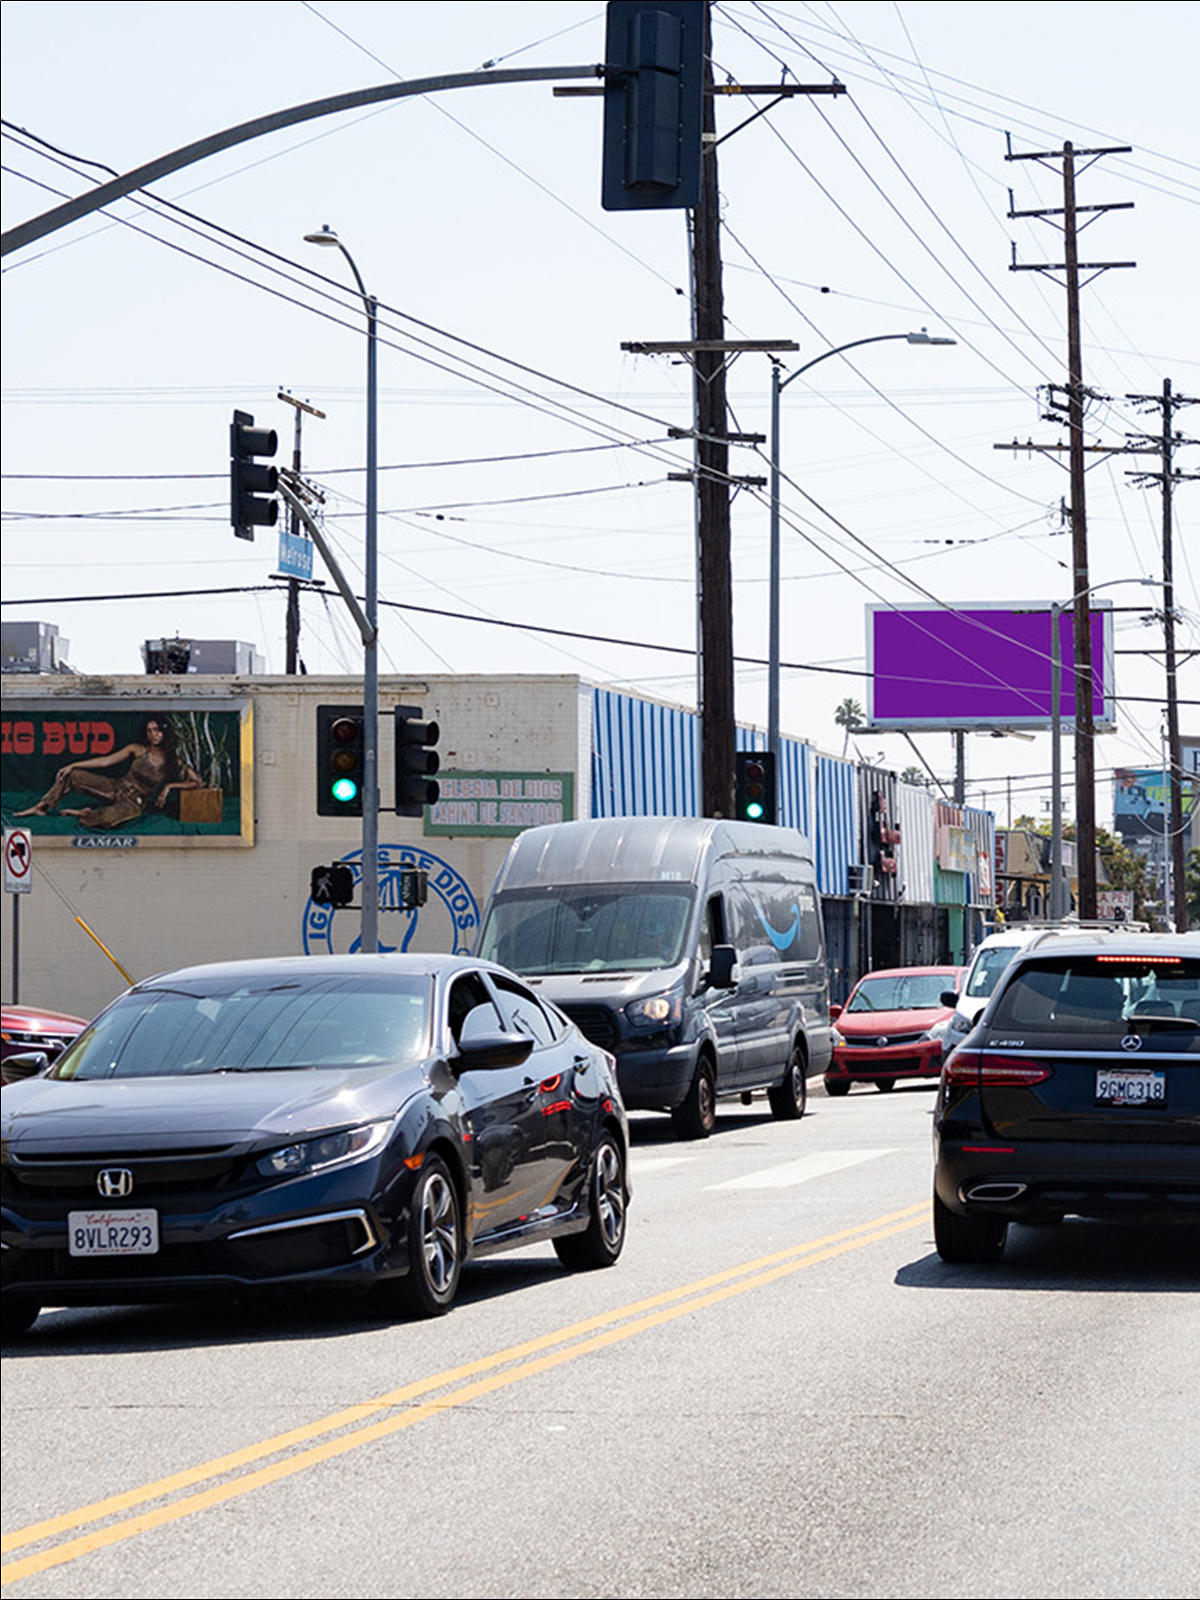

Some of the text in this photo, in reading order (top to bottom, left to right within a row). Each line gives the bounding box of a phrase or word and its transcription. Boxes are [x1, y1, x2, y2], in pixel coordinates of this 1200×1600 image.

[43, 722, 115, 754] BUD
[440, 779, 562, 800] GLESIA DE DIOS
[480, 802, 497, 825] DE
[75, 837, 134, 847] LAMAR
[1099, 1080, 1163, 1100] 9GMC318
[74, 1226, 152, 1250] 8VLR293
